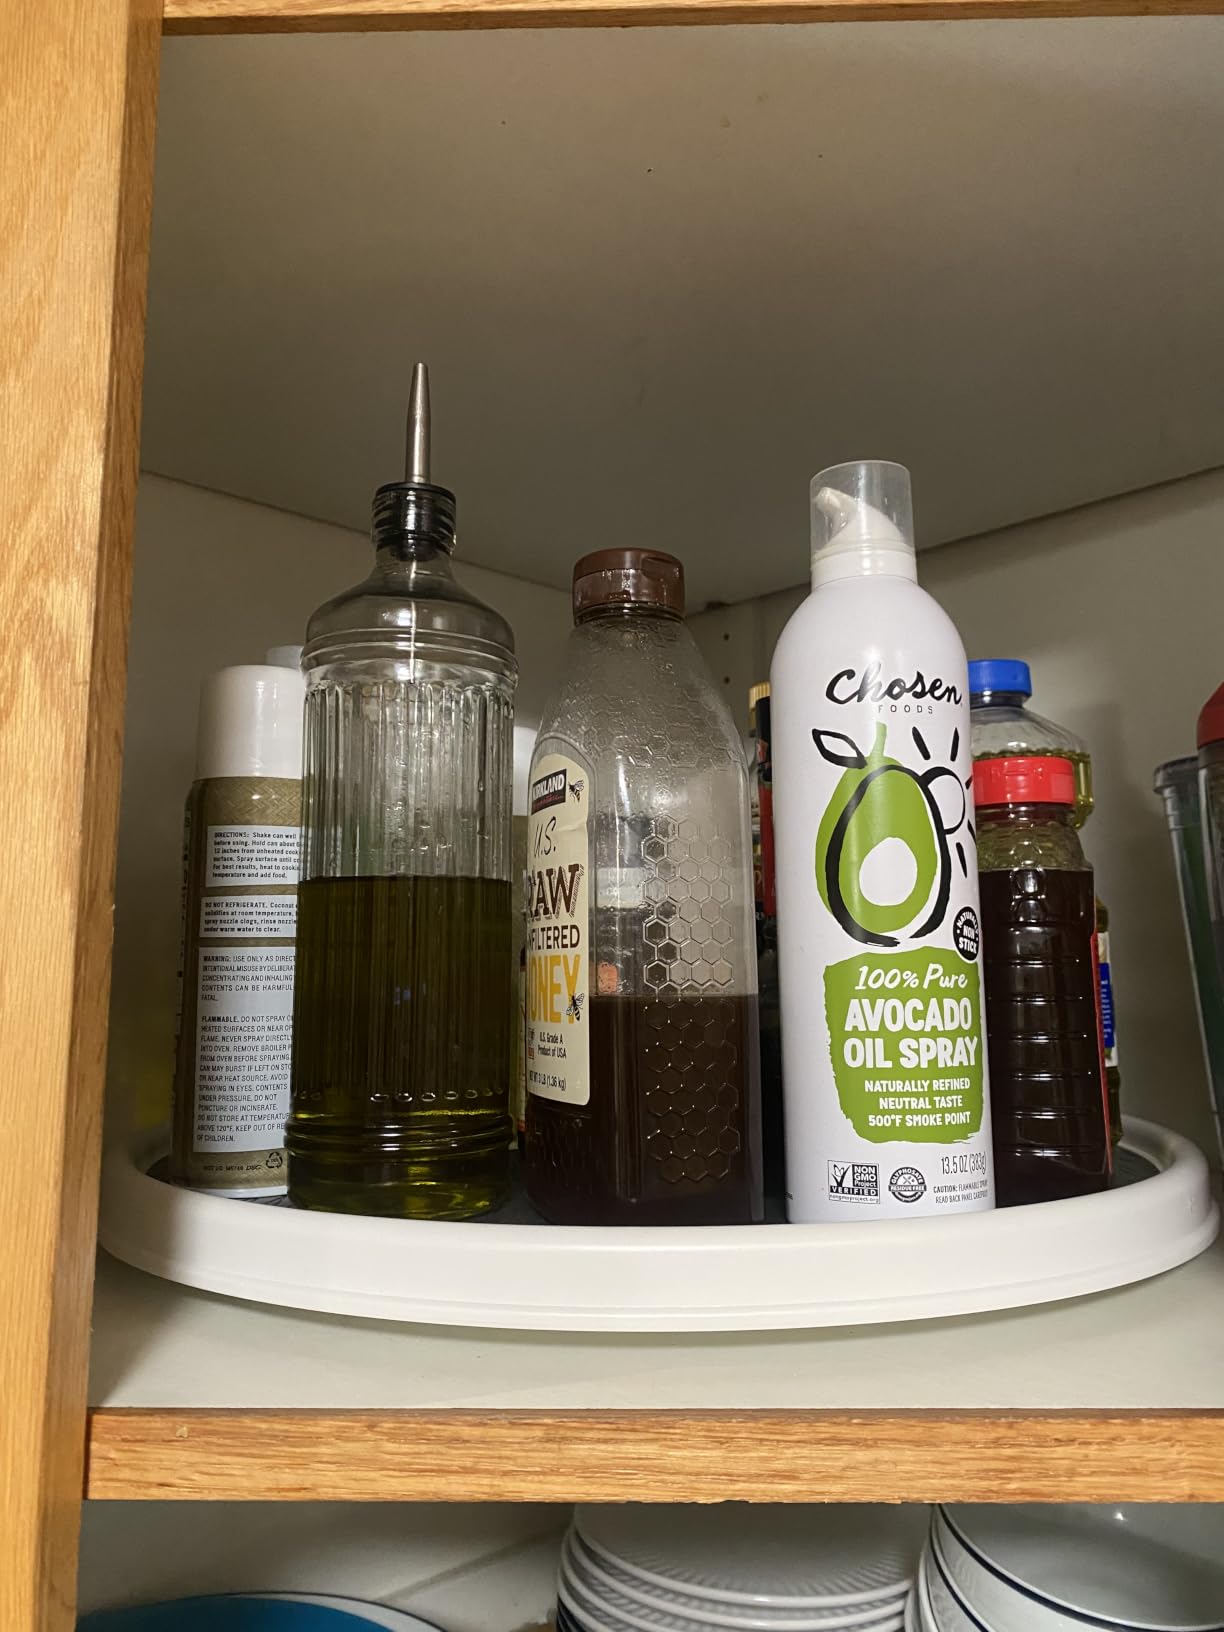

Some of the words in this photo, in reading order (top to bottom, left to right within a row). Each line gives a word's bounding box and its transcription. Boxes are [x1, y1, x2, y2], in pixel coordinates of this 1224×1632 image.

[825, 659, 962, 705] Chosen
[878, 705, 933, 714] FOODS
[533, 774, 565, 800] KIRKLAND
[534, 816, 556, 858] U.S.
[528, 924, 580, 951] FILTERED
[963, 925, 975, 940] NON
[958, 936, 977, 954] STICK
[854, 965, 920, 990] 100%
[922, 963, 968, 990] Pure
[844, 997, 972, 1032] AVOCADO
[843, 1038, 893, 1068] OIL
[898, 1036, 978, 1068] SPRAY
[256, 1084, 288, 1092] CONTENTS
[864, 1080, 930, 1092] NATURALLY
[932, 1078, 970, 1091] REFINED
[879, 1096, 932, 1110] NEUTRAL
[934, 1096, 963, 1108] TASTE
[250, 1112, 290, 1122] TEMPERATUR
[868, 1114, 902, 1127] 500°F
[906, 1114, 943, 1126] SMOKE
[945, 1112, 970, 1124] POINT
[854, 1166, 876, 1174] NON
[941, 1155, 958, 1174] 13.5
[959, 1154, 968, 1173] OZ
[854, 1174, 876, 1182] GMO
[891, 1168, 924, 1184] GLYPHOSATE
[832, 1186, 876, 1196] VERIFIED
[933, 1184, 958, 1194] CAUTION:
[936, 1196, 948, 1204] READ
